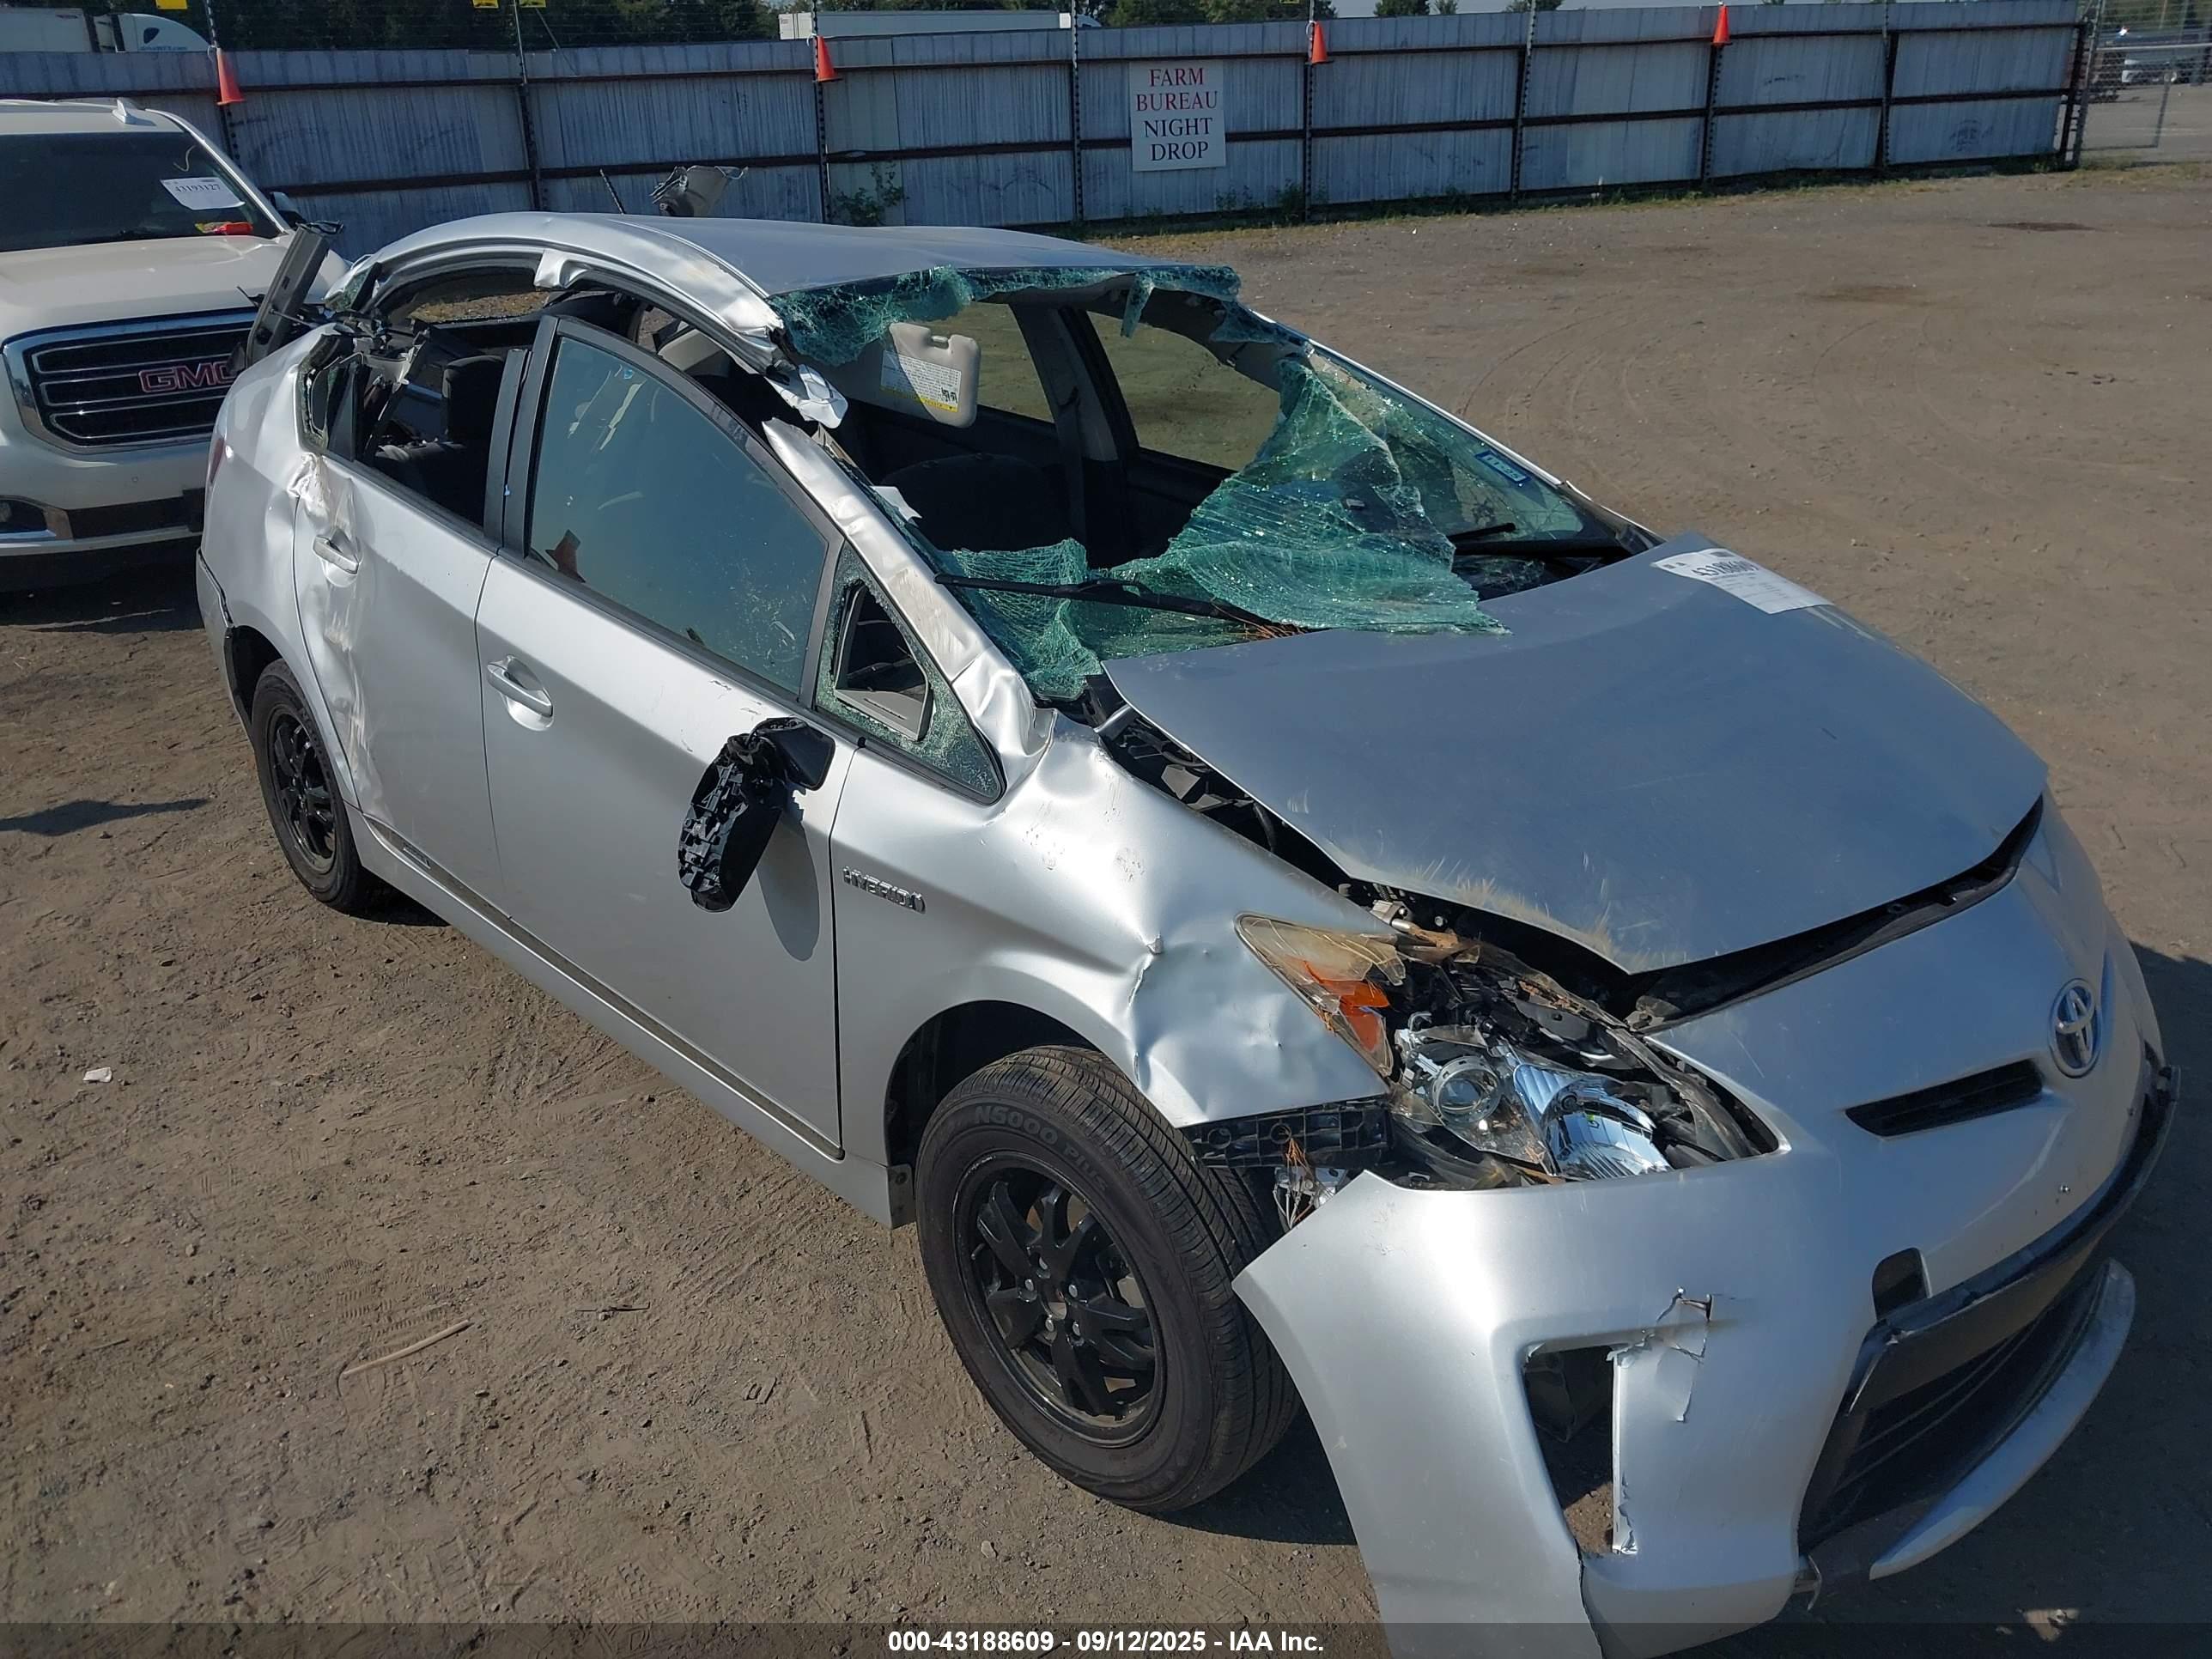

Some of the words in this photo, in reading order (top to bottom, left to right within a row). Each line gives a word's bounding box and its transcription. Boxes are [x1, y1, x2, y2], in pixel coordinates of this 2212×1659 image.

[1149, 68, 1204, 87] FARM
[1135, 91, 1218, 112] BUREAU
[1143, 117, 1212, 137] NIGHT
[1151, 141, 1208, 161] DROP
[138, 362, 236, 392] GMC
